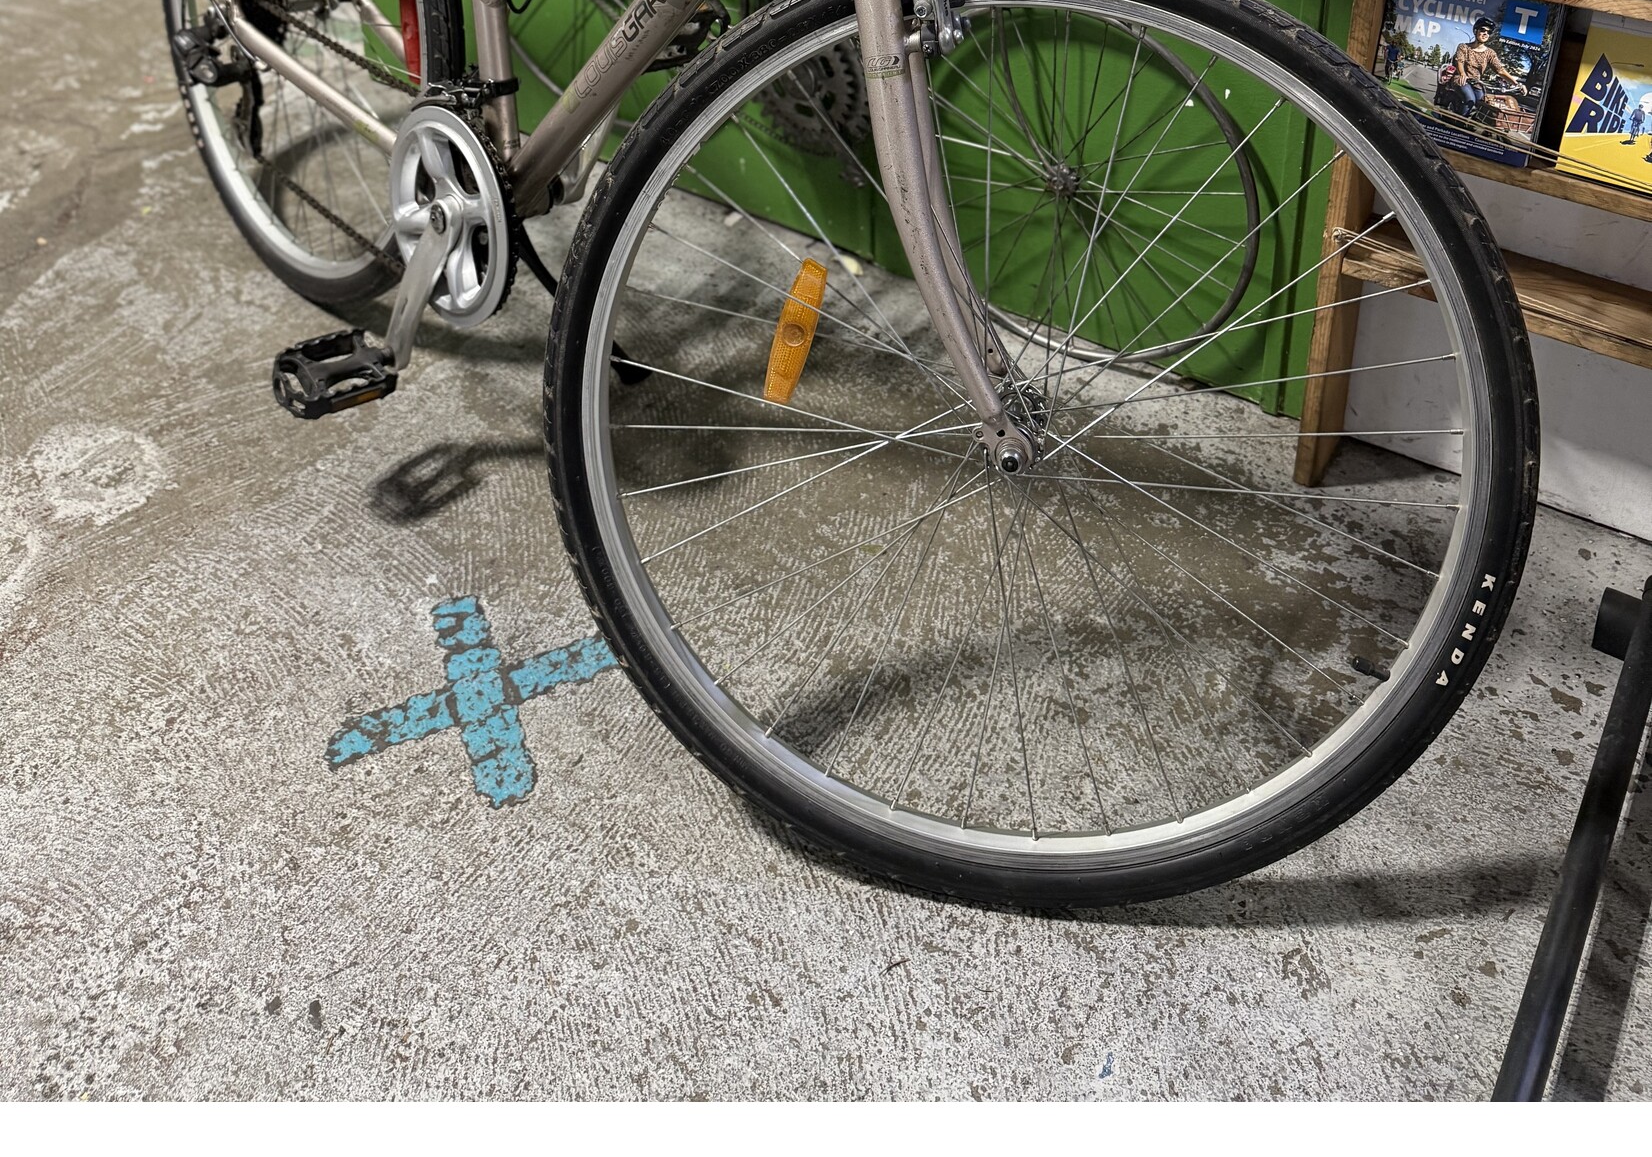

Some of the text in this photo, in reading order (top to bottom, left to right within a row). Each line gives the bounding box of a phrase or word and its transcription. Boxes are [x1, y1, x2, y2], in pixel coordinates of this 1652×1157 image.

[1394, 14, 1441, 38] MAP
[1515, 6, 1538, 35] T
[1581, 53, 1629, 116] BIKE
[1565, 97, 1625, 134] RIDE
[1435, 573, 1497, 686] KENDA
